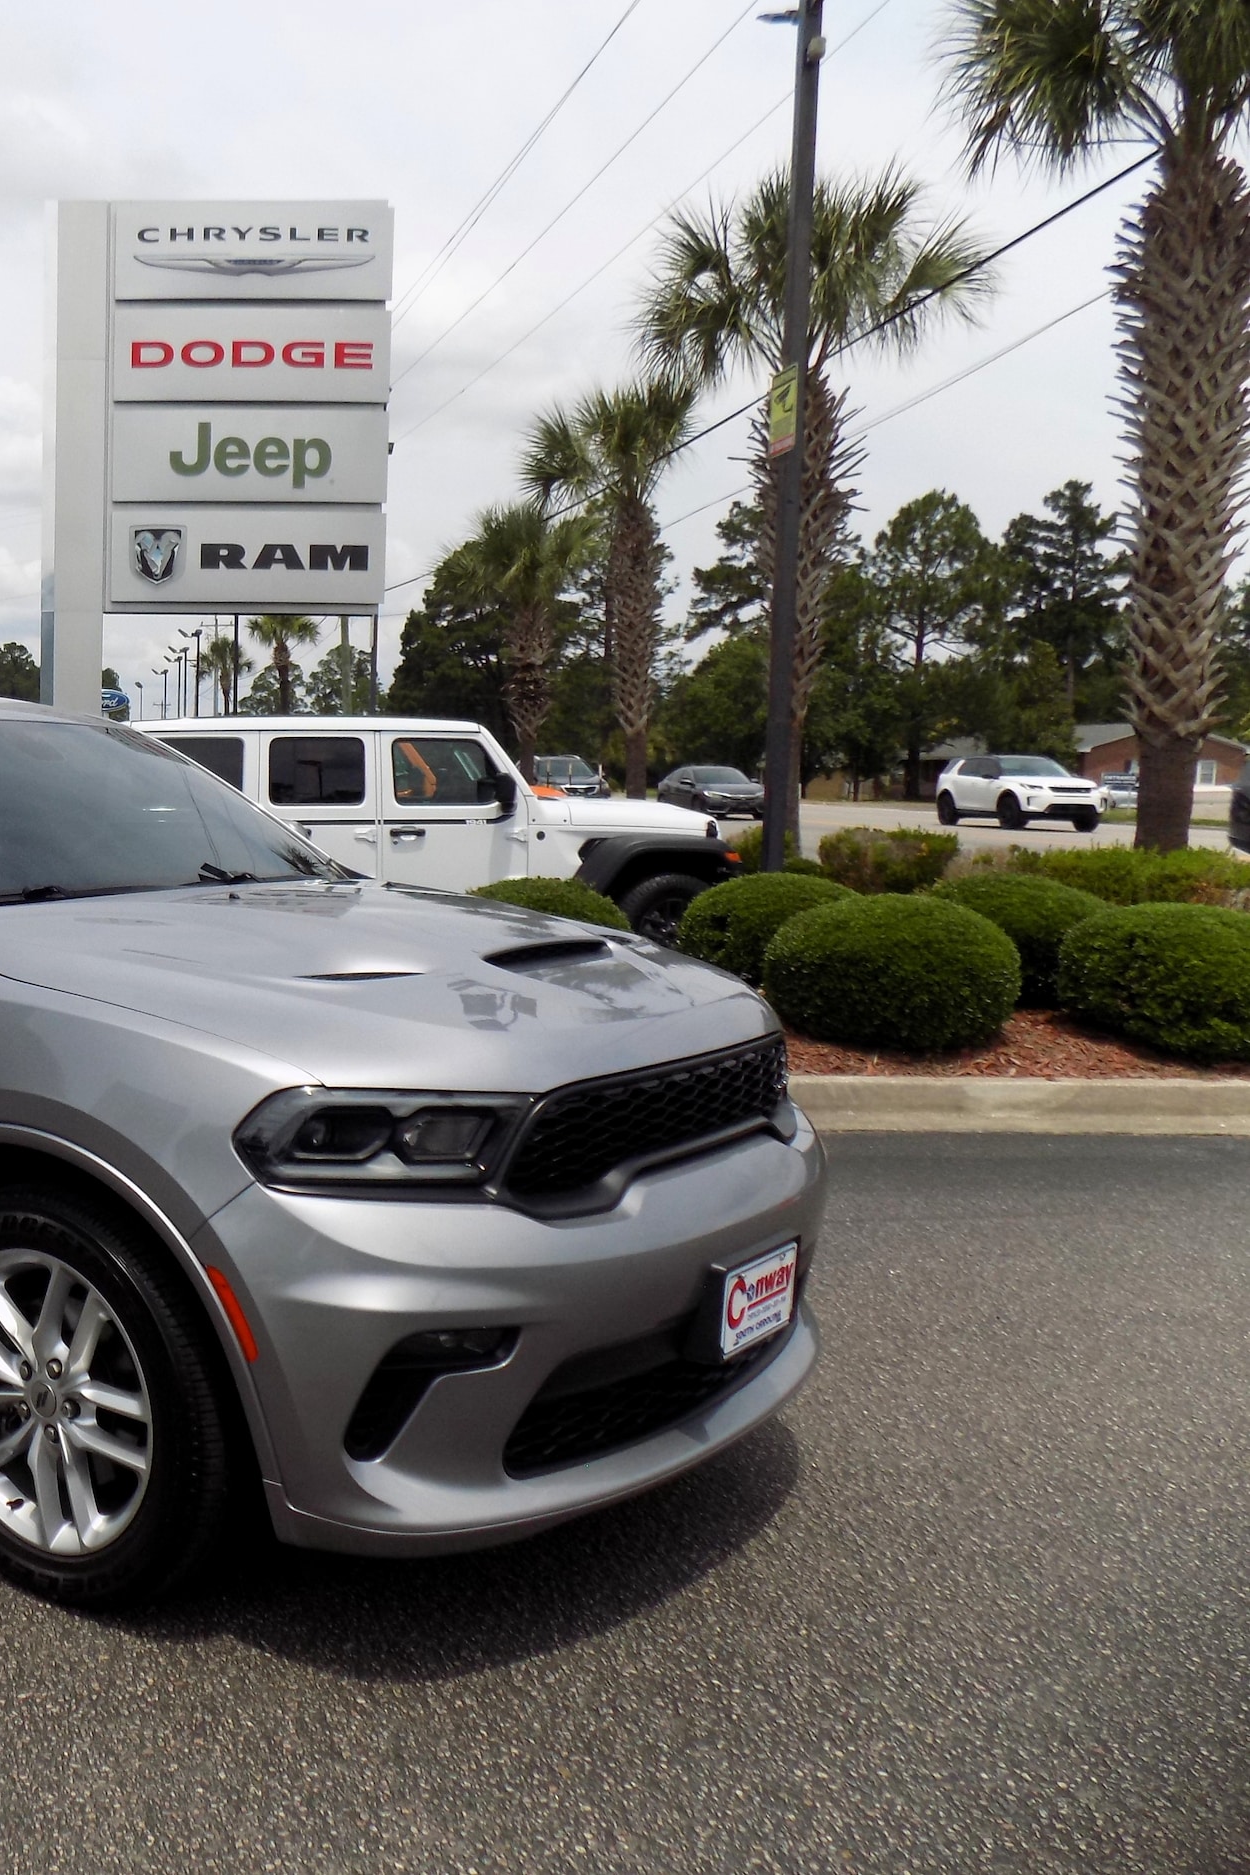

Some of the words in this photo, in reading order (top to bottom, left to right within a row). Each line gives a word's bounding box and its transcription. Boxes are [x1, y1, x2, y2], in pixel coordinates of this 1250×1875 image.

[137, 226, 371, 243] CHRYSLER
[131, 340, 374, 369] DODGE
[169, 422, 332, 489] Jeep
[200, 543, 369, 571] RAM
[727, 1262, 794, 1330] Conway
